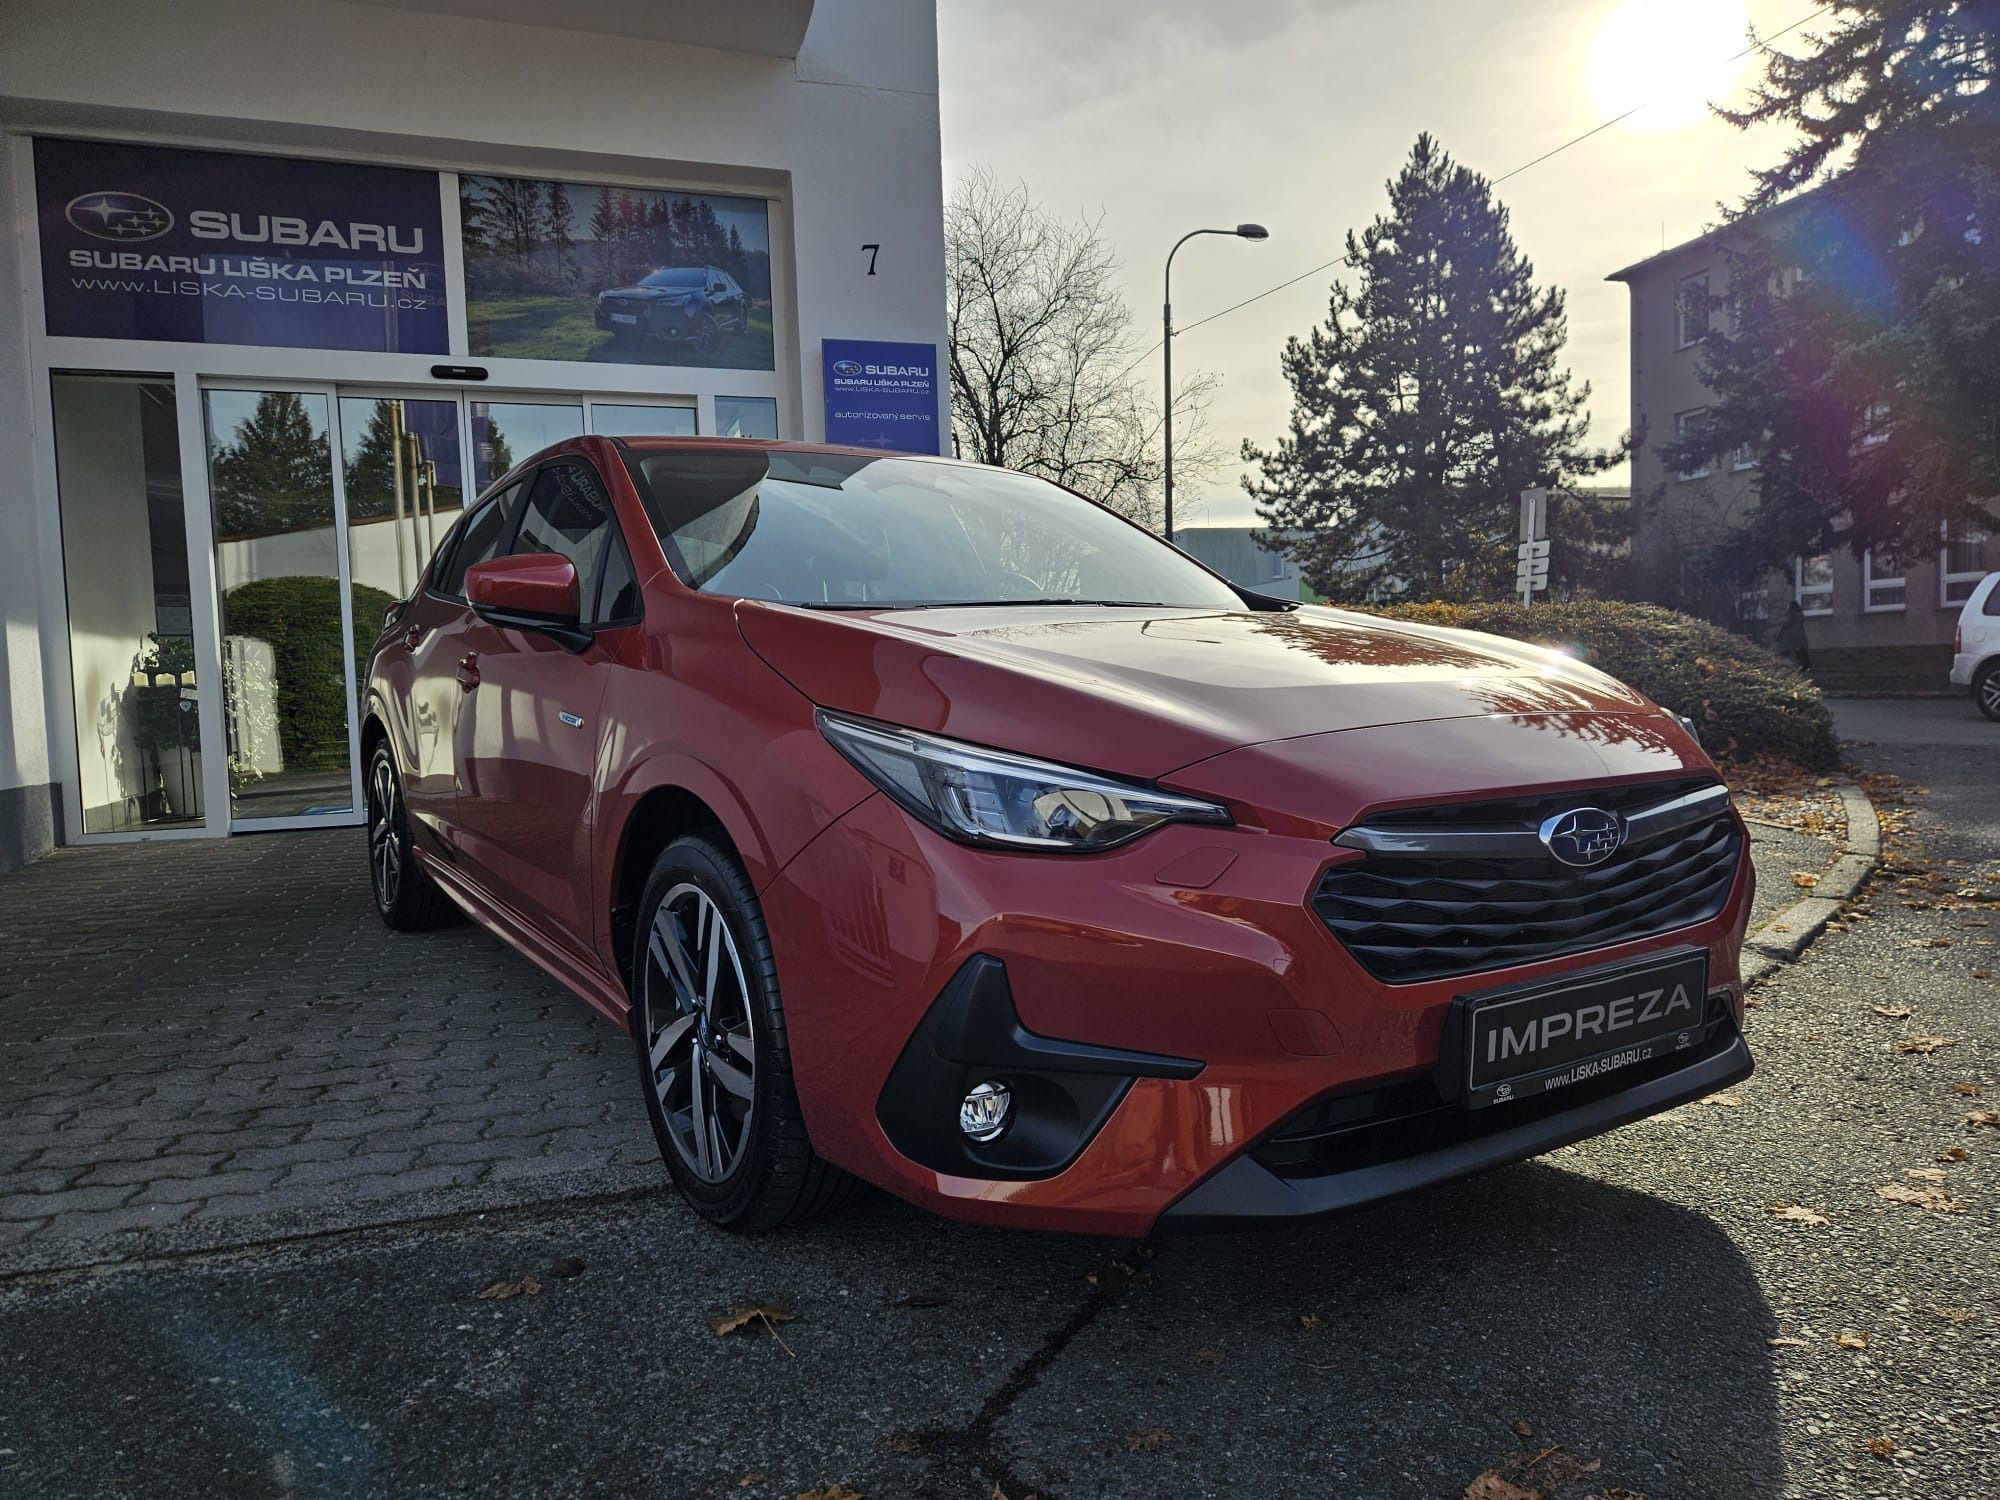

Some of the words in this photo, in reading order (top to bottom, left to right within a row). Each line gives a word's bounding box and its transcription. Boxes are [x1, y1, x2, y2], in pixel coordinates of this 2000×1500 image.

[190, 210, 424, 255] SUBARU
[69, 250, 216, 276] SUBARU
[223, 256, 318, 282] LIŠKA
[324, 266, 426, 290] PLZEŇ
[861, 244, 880, 275] 7
[71, 277, 428, 310] www.LISKA-SUBARU.cz
[834, 378, 873, 386] SUBARU
[874, 378, 900, 387] LIŠKA
[865, 365, 929, 377] SUBARU
[834, 411, 899, 421] autorizovaný
[900, 412, 931, 421] servis
[1487, 983, 1691, 1063] IMPREZA
